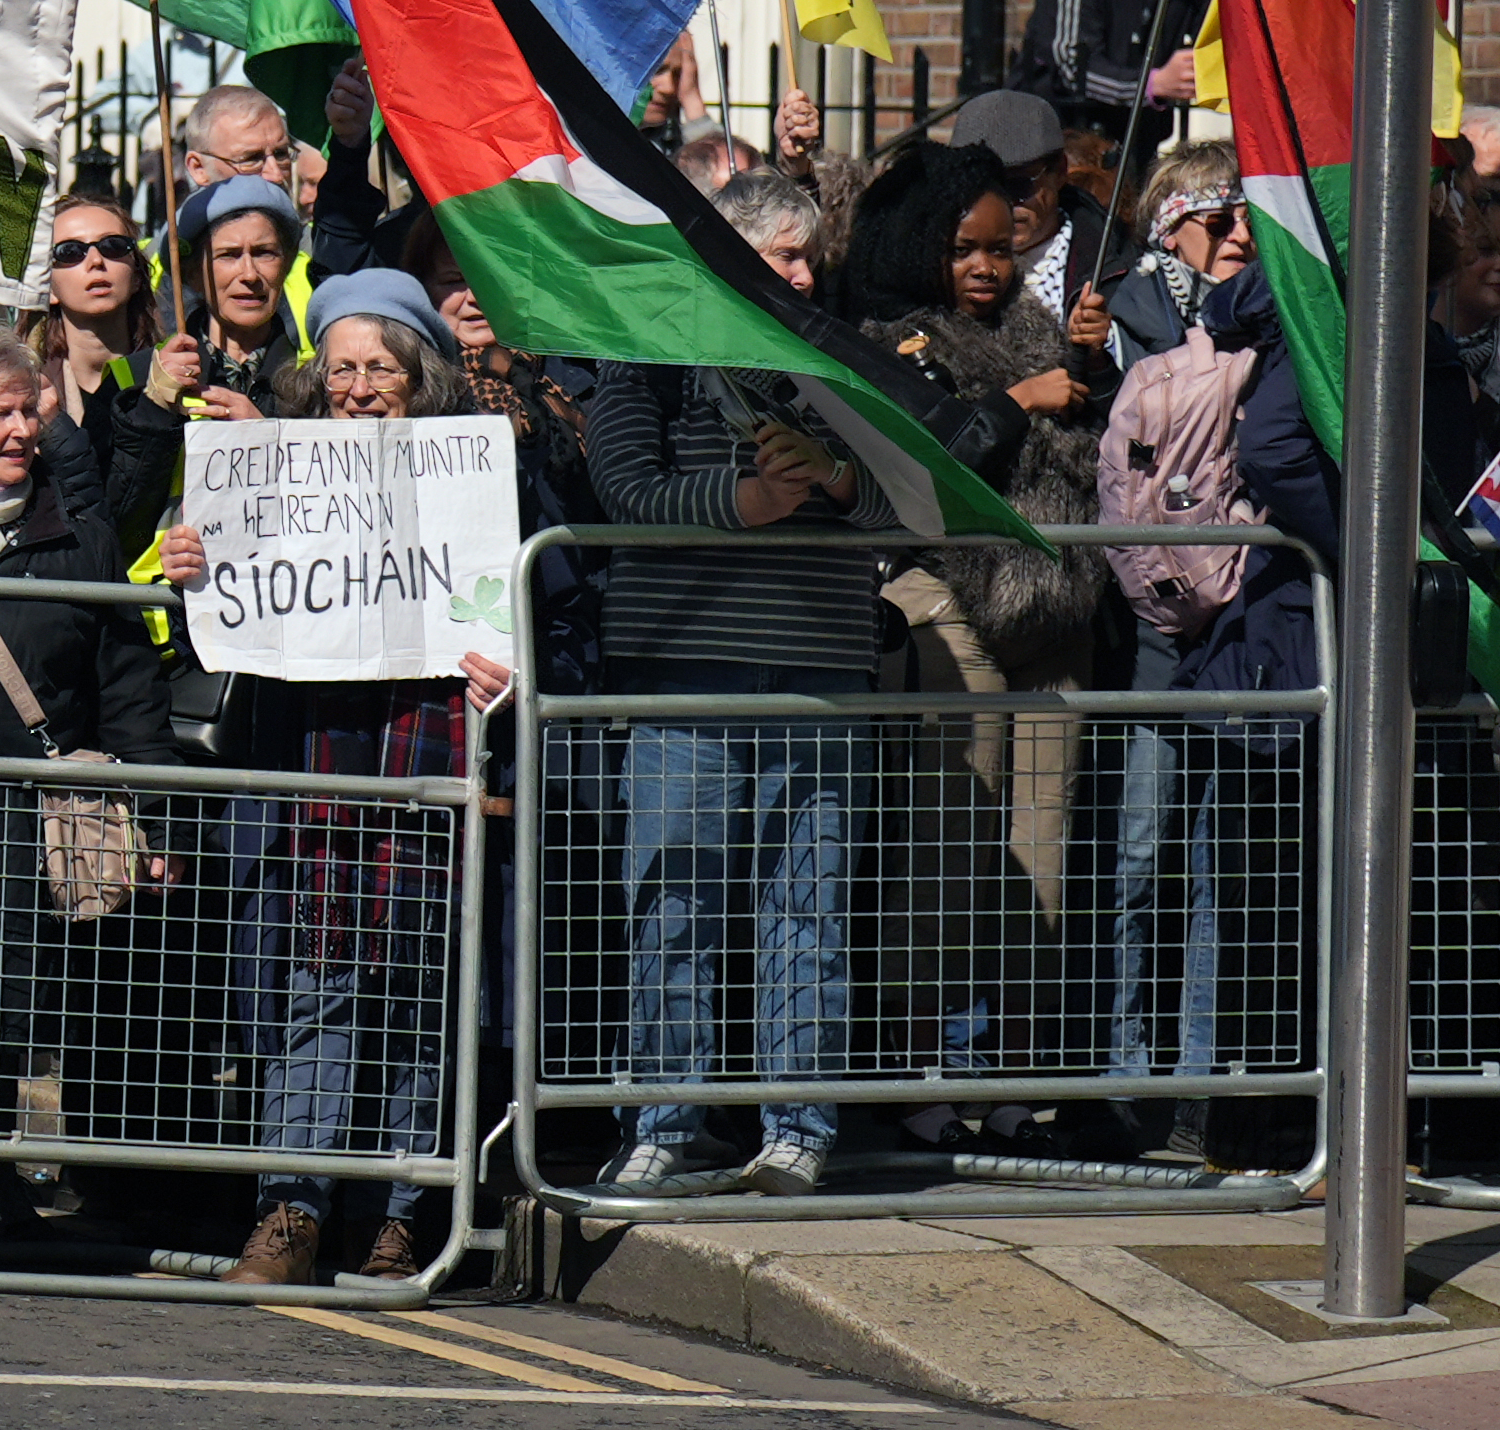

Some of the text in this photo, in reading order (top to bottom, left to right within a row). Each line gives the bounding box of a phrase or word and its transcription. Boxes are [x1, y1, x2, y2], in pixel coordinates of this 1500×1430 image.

[205, 434, 492, 492] CREIDEANN MUINTIR
[202, 522, 223, 536] NA
[213, 540, 454, 629] SÍOCHÁIN
